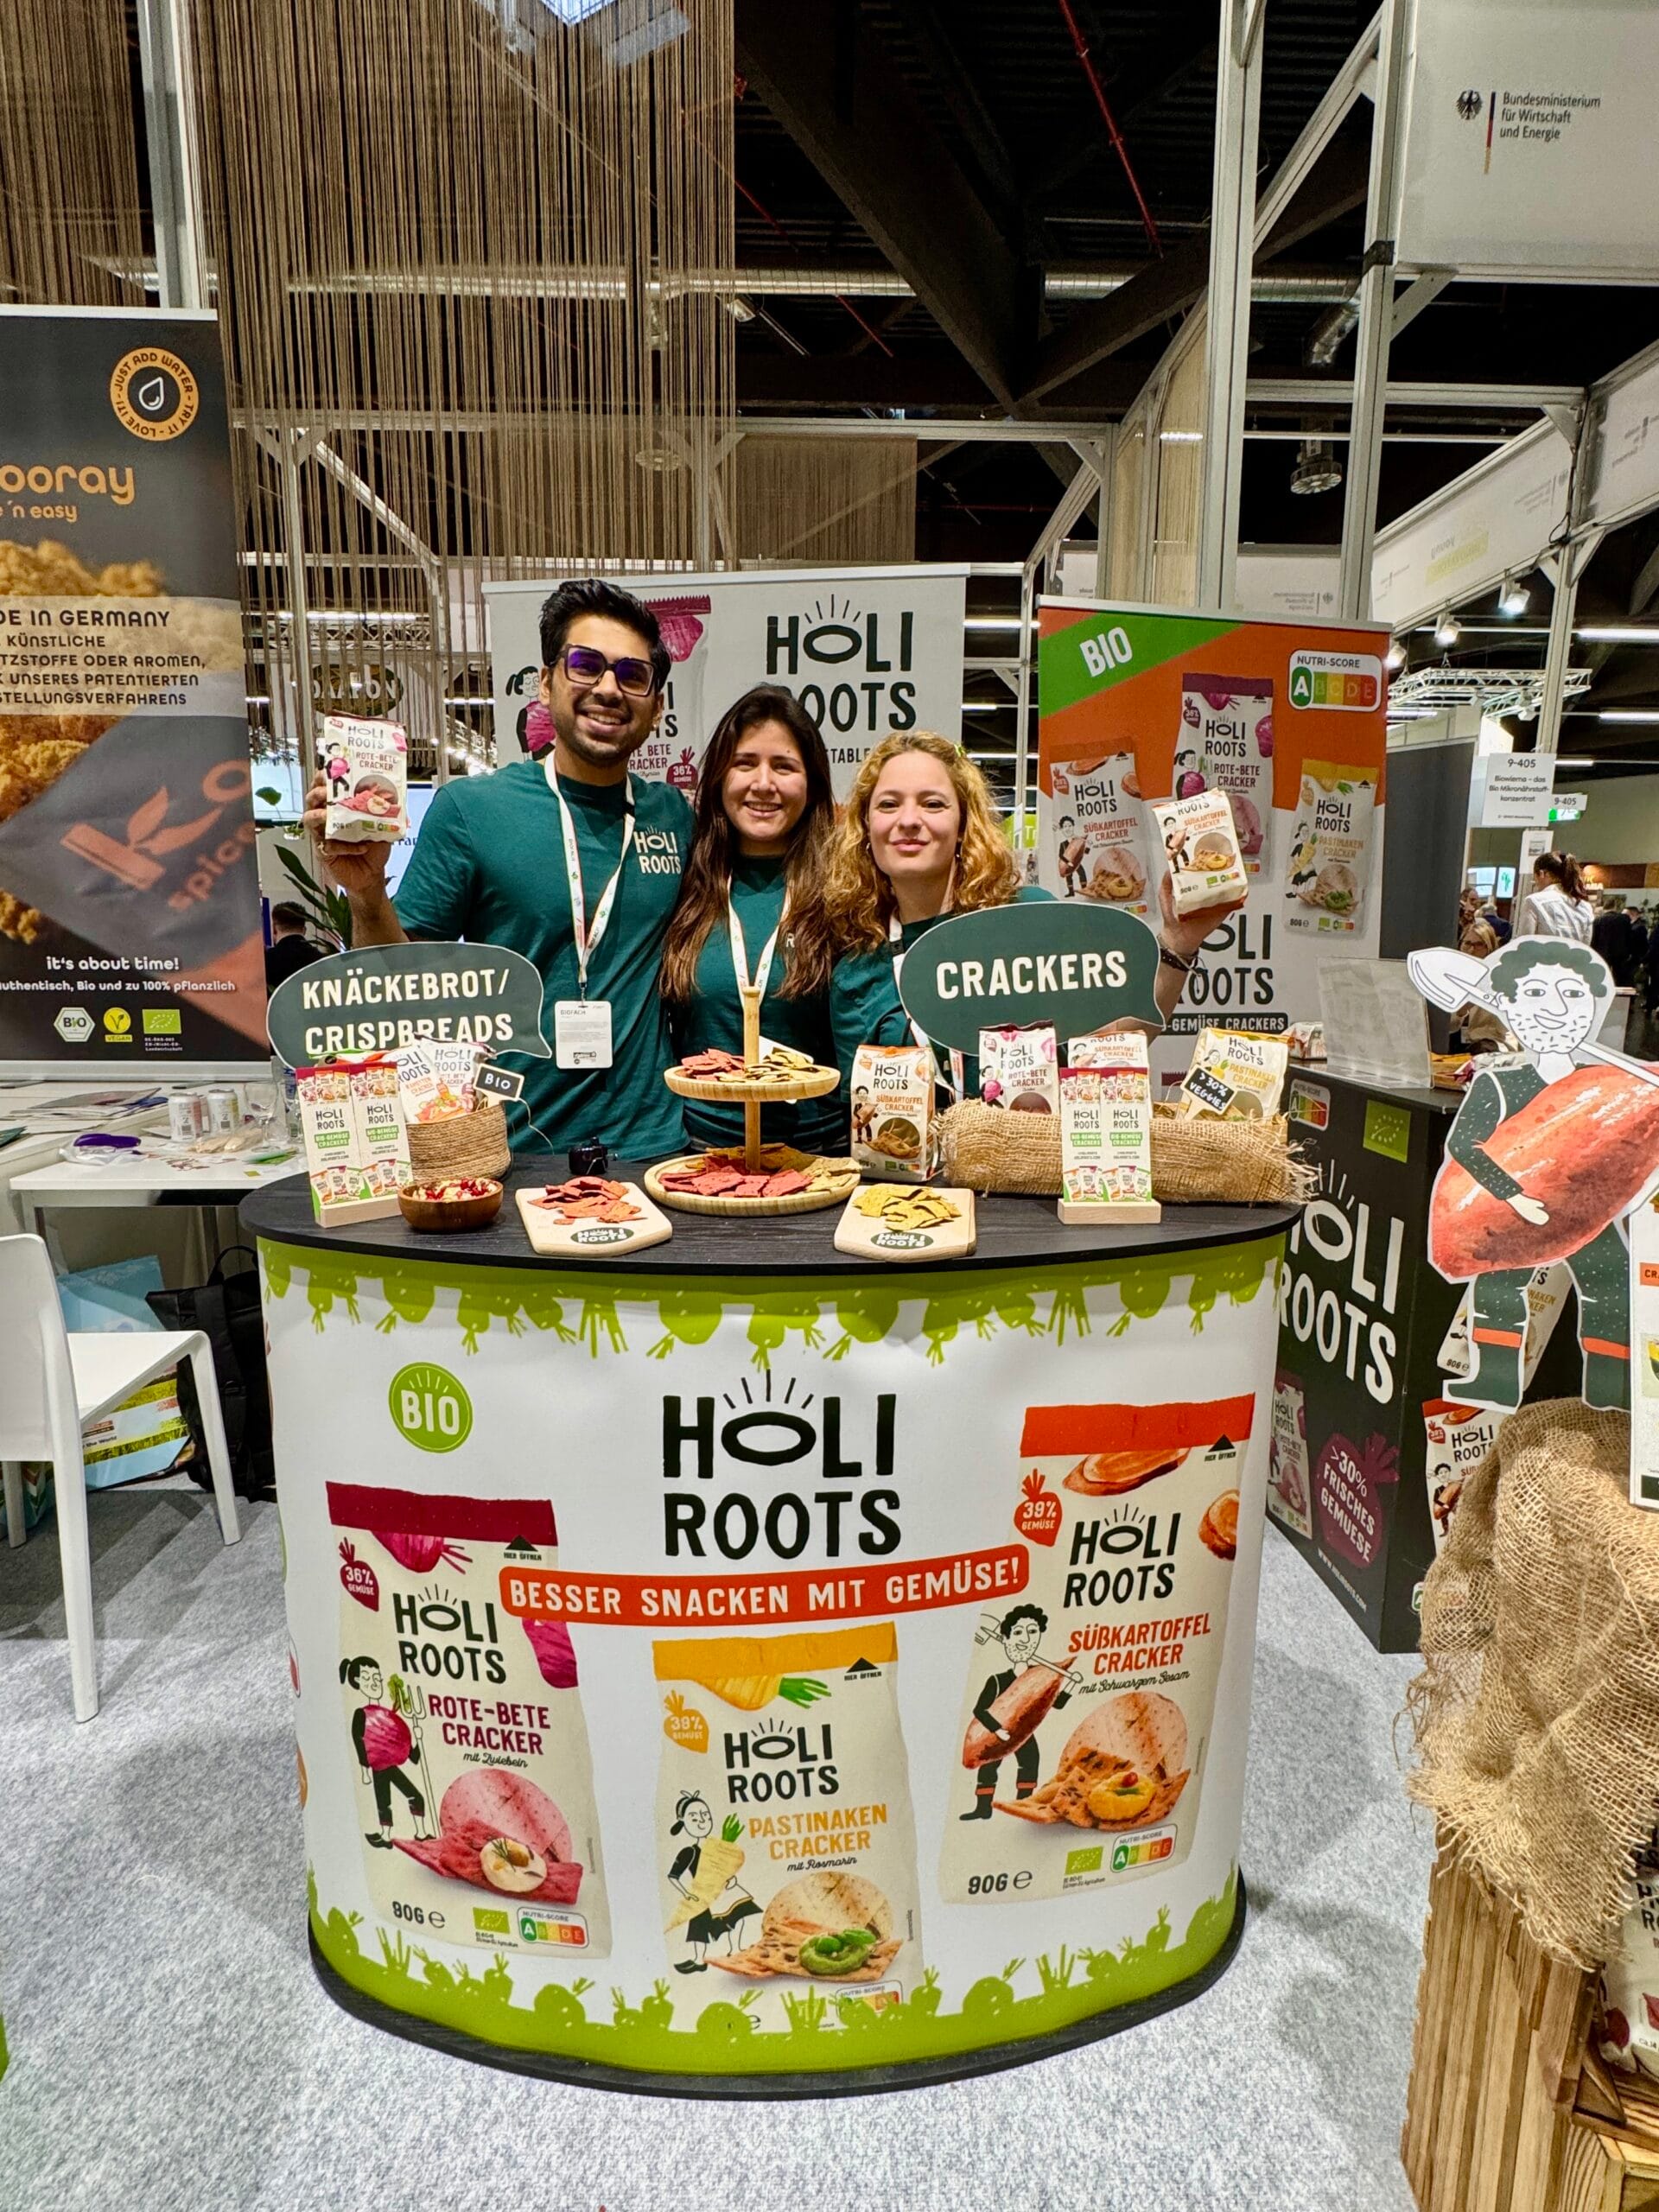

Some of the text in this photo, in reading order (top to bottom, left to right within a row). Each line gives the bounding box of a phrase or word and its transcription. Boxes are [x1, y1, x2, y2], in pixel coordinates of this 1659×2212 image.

[1503, 92, 1601, 108] Bundesministerium
[1501, 108, 1572, 124] für Wirtschaft
[1499, 126, 1560, 143] und Energie
[114, 352, 194, 393] JUST ADD WATER
[126, 416, 157, 437] LOVE
[168, 404, 194, 436] TRY IT
[29, 505, 78, 523] easy
[30, 610, 170, 627] IN GERMANY
[7, 632, 106, 648] KÜNSTLICHE
[766, 611, 914, 675] HOLI
[1079, 626, 1134, 677] BIO
[84, 654, 128, 667] ODER
[134, 655, 206, 669] AROMEN,
[1297, 656, 1361, 669] NUTRI-SCORE
[10, 673, 200, 687] UNSERES PATENTIERTEN
[1293, 676, 1310, 698] A
[347, 725, 385, 740] HOLI
[1205, 719, 1246, 741] HOLI
[347, 737, 385, 750] ROOTS
[647, 744, 671, 756] BETE
[1205, 741, 1247, 757] ROOTS
[355, 751, 398, 765] ROTE-BETE
[359, 760, 394, 772] CRACKER
[628, 757, 668, 771] RACKER
[1508, 759, 1536, 768] 9-405
[672, 765, 692, 776] 36%
[1214, 763, 1261, 776] ROTE-BETE
[1217, 776, 1256, 787] CRACKER
[1074, 779, 1115, 801] HOLI
[1077, 798, 1117, 817] ROOTS
[1317, 798, 1351, 818] HOLI
[1554, 797, 1577, 805] 9-405
[1193, 818, 1220, 831] CRACKER
[1314, 817, 1351, 833] ROOTS
[632, 831, 678, 854] HOLI
[1095, 830, 1129, 842] CRACKER
[1319, 836, 1364, 849] PASTINAKEN
[1323, 847, 1357, 859] CRACKER
[639, 855, 682, 874] ROOTS
[79, 957, 130, 970] about
[134, 957, 180, 970] time!
[937, 950, 1128, 1000] CRACKERS
[77, 980, 95, 991] Bio
[99, 979, 123, 991] und
[125, 982, 140, 991] zu
[143, 980, 170, 991] 100%
[174, 980, 236, 993] pflanzlich
[302, 968, 510, 1010] KNÄCKEBROT/
[1225, 1017, 1285, 1031] CRACKERS
[305, 1013, 514, 1054] CRISPBREADS
[435, 1048, 471, 1060] HOLI
[1229, 1037, 1262, 1056] HOLI
[1227, 1046, 1264, 1065] ROOTS
[434, 1061, 471, 1072] ROOTS
[874, 1064, 909, 1077] HOLI
[1007, 1069, 1048, 1079] ROTE-BETE
[484, 1072, 511, 1090] BIO
[873, 1078, 909, 1090] ROOTS
[1011, 1078, 1046, 1087] CRACKER
[1207, 1077, 1229, 1097] 30%
[1232, 1074, 1269, 1090] CRACKER
[1188, 1082, 1226, 1111] VEGGIES
[315, 1109, 344, 1121] HOLI
[366, 1103, 393, 1116] HOLI
[884, 1103, 914, 1113] CRACKER
[1073, 1109, 1099, 1120] HOLI
[1113, 1109, 1139, 1120] HOLI
[317, 1120, 345, 1130] ROOTS
[368, 1114, 395, 1124] ROOTS
[576, 1234, 628, 1243] ROOTS
[577, 1228, 626, 1237] HOLI
[878, 1233, 926, 1242] HOLI
[875, 1239, 925, 1248] ROOTS
[401, 1389, 461, 1436] BIO
[1274, 1415, 1294, 1435] ROOTS
[663, 1394, 897, 1479] HOLI
[1452, 1424, 1495, 1449] HOLI
[1324, 1462, 1376, 1535] FRISCHES
[1023, 1500, 1057, 1519] 39%
[664, 1489, 901, 1560] ROOTS
[1021, 1519, 1056, 1530] GEMÜSE
[1320, 1487, 1372, 1563] GEMUESE
[1069, 1512, 1181, 1566] HOLI
[346, 1565, 373, 1586] 36%
[347, 1583, 375, 1597] GEMÜSE
[509, 1556, 1020, 1618] BESSER SNACKEN MIT GEMÜSE!
[1063, 1562, 1175, 1609] ROOTS
[392, 1592, 499, 1643] HOLI
[398, 1640, 506, 1684] ROOTS
[1093, 1643, 1184, 1675] CRACKER
[1078, 1670, 1191, 1694] mit Schwarzem Sesam
[428, 1694, 551, 1729] ROTE-BETE
[442, 1722, 544, 1756] CRACKER
[672, 1731, 703, 1739] GEMÜSE
[723, 1724, 833, 1769] HOLI
[463, 1751, 480, 1763] mit
[728, 1765, 840, 1803] ROOTS
[748, 1802, 888, 1839] PASTINAKEN
[769, 1830, 871, 1860] CRACKER
[1119, 1831, 1163, 1845] NUTRI-SCORE
[787, 1856, 857, 1872] mit Rosmarin
[1115, 1851, 1127, 1865] A
[968, 1872, 1009, 1895] 90G
[523, 1910, 569, 1923] NUTRI-SCORE
[524, 1923, 535, 1936] A
